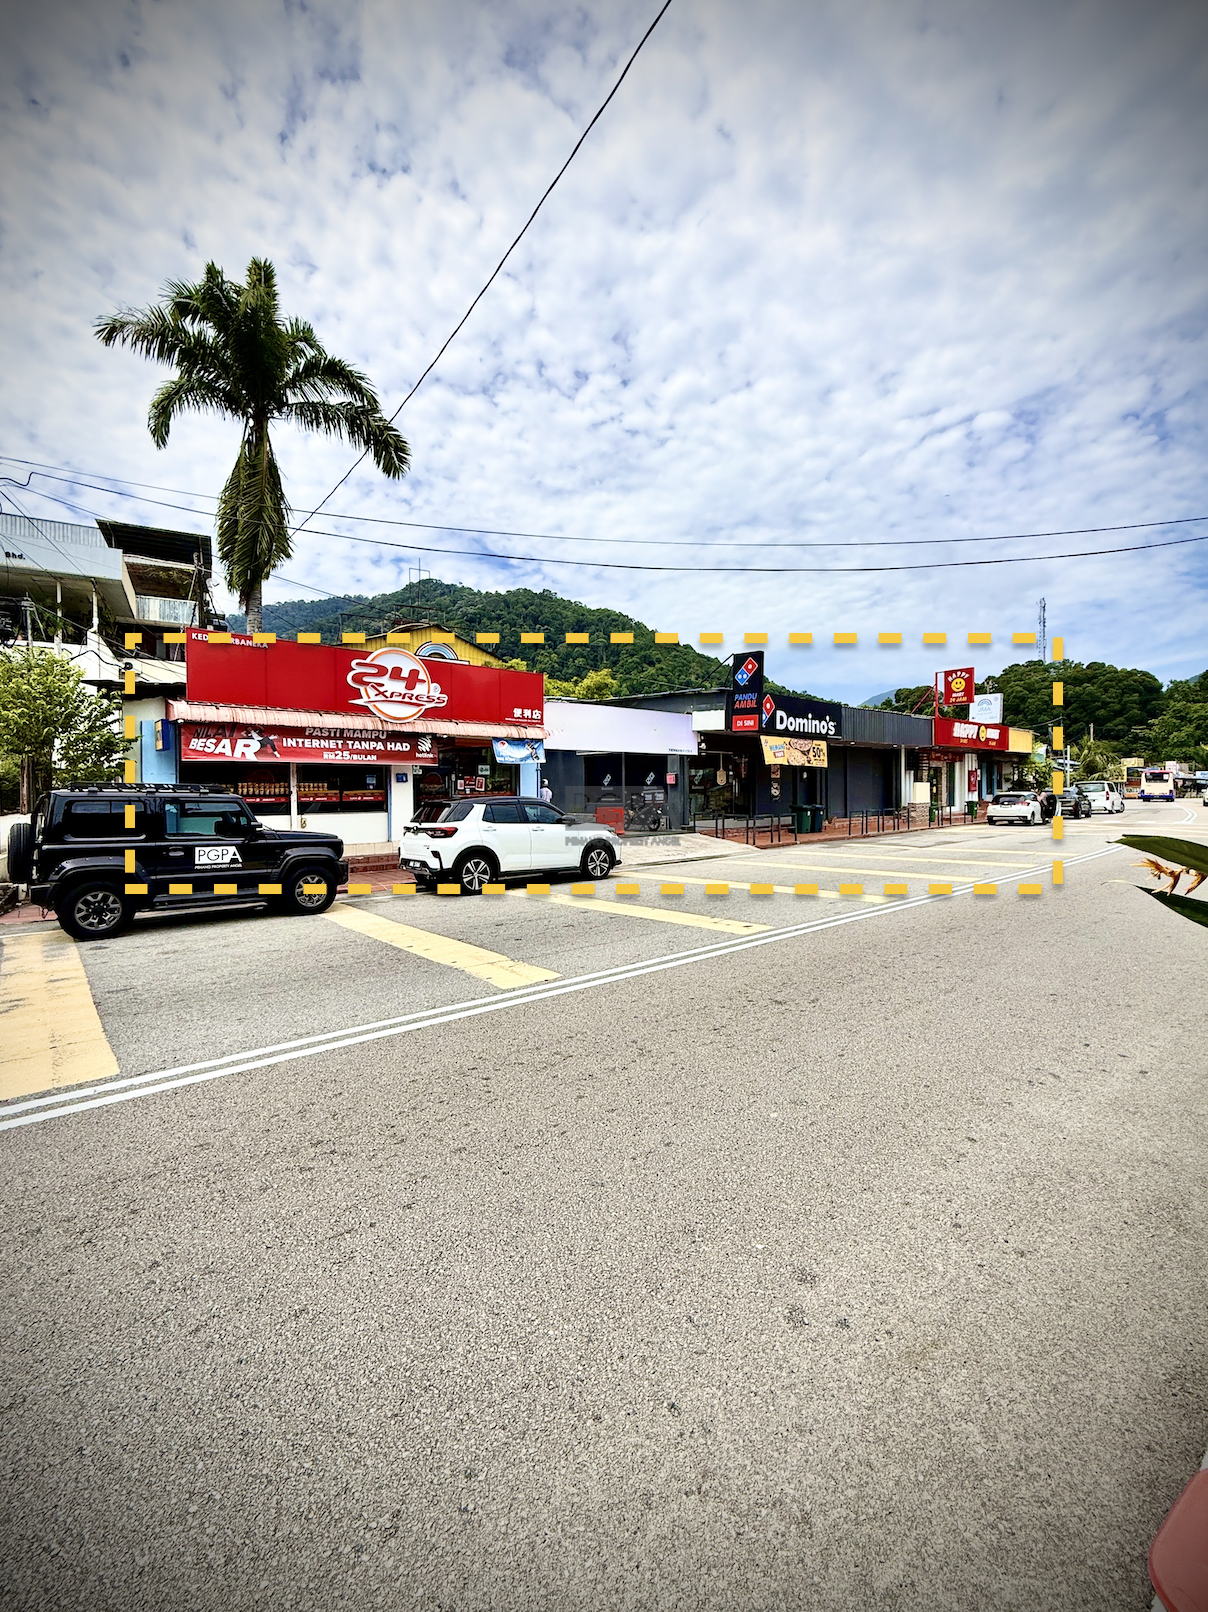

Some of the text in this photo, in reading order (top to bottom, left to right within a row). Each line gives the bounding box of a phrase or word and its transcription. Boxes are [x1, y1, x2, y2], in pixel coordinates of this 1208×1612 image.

[4, 551, 26, 560] Bhd.
[351, 661, 427, 691] 24
[948, 671, 969, 682] HAPPY
[370, 684, 447, 704] XPRESS
[734, 692, 758, 701] PANDU
[734, 699, 758, 709] AMBIL
[513, 707, 542, 720] 便利店
[775, 709, 836, 735] Domino's
[193, 723, 238, 738] NILAI
[305, 727, 388, 740] PASTI MAMPU
[953, 722, 978, 739] HAPPY
[188, 738, 261, 761] BESAR
[282, 737, 411, 752] INTERNET TANPA HAD
[198, 847, 243, 863] PGPA
